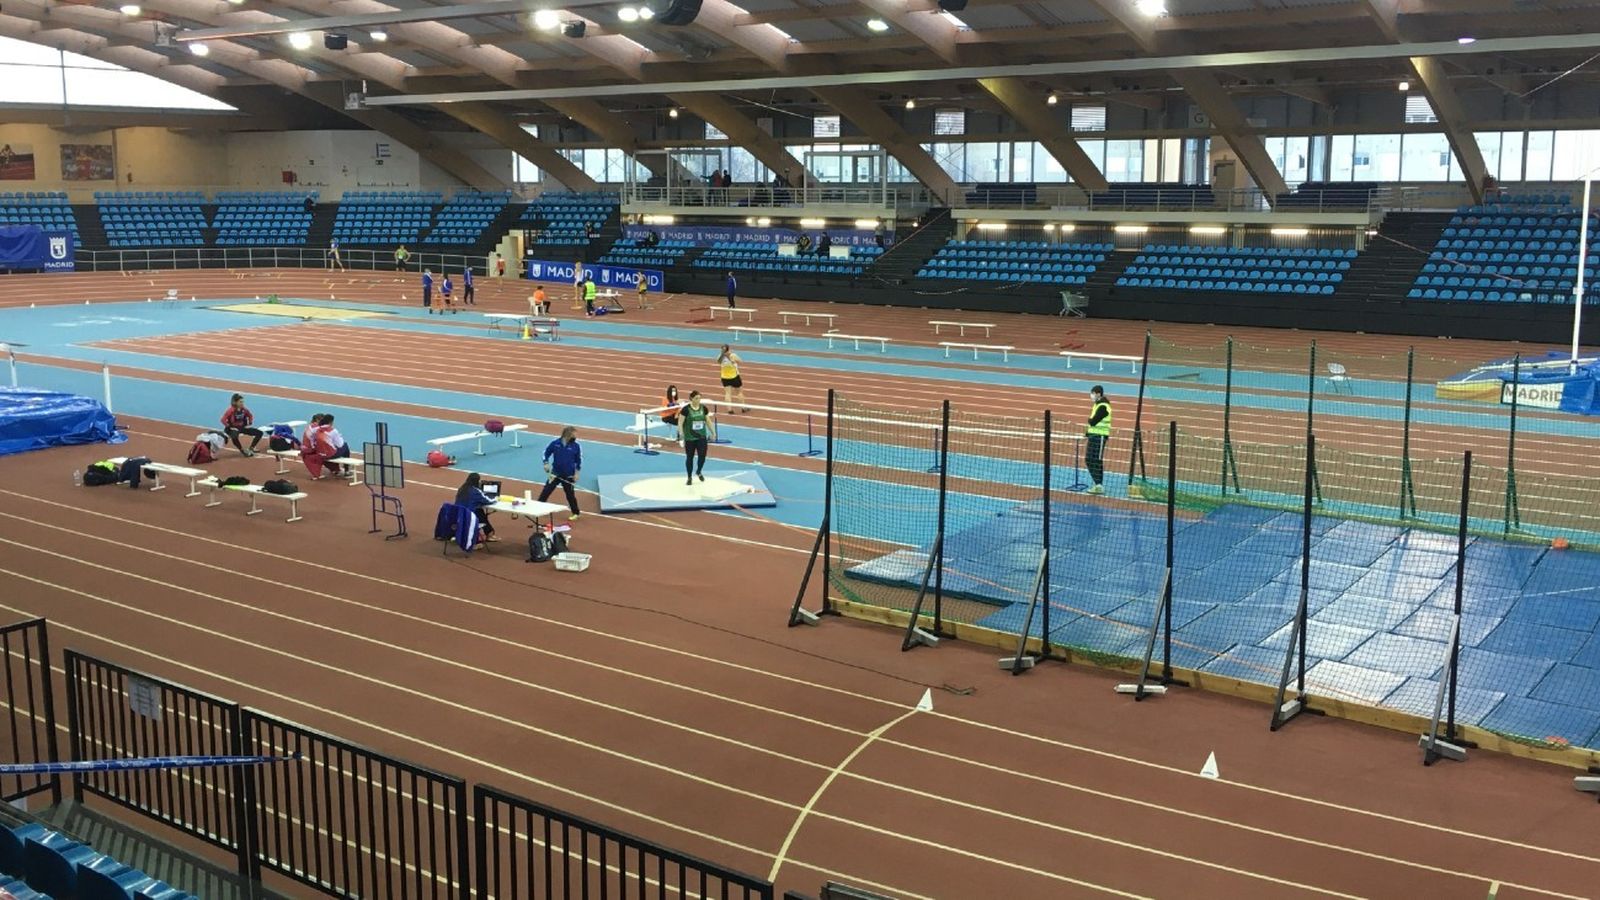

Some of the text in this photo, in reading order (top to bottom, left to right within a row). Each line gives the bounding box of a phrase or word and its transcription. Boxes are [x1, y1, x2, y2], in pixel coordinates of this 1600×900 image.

[743, 233, 770, 242] MADRID
[44, 261, 74, 269] MADRID
[547, 266, 593, 280] MADID
